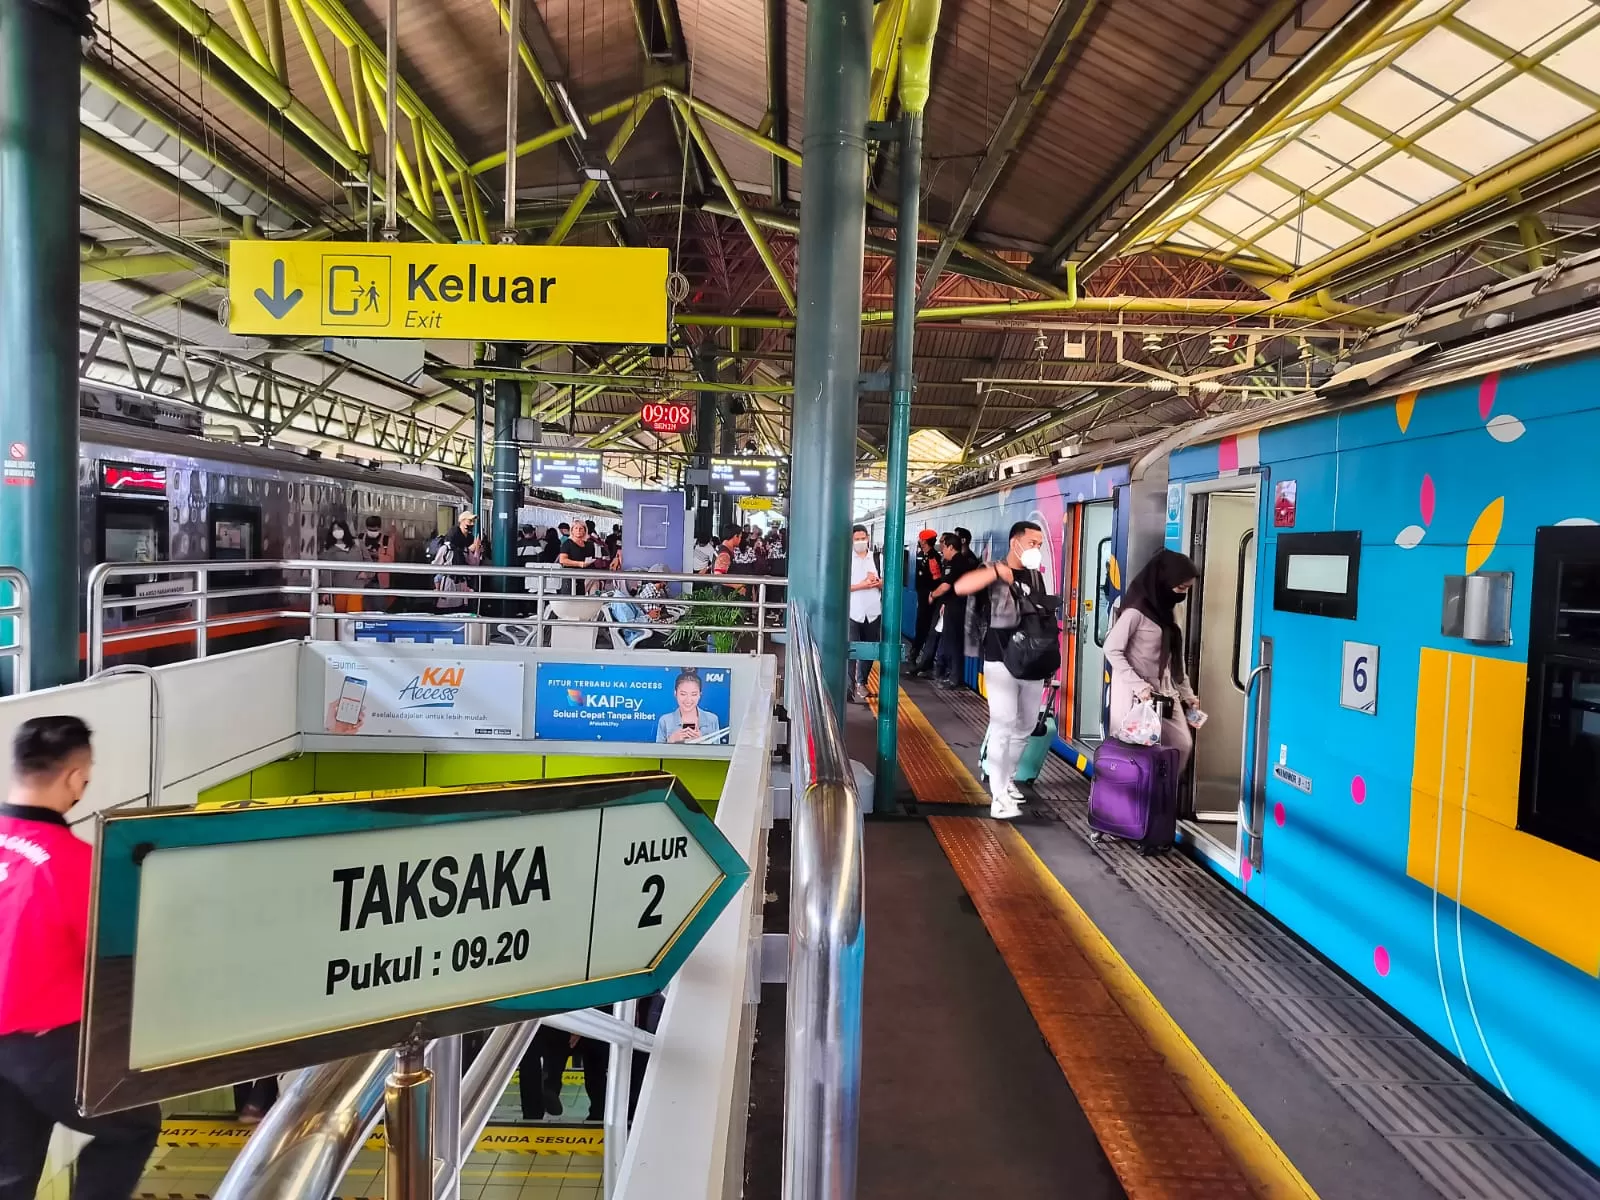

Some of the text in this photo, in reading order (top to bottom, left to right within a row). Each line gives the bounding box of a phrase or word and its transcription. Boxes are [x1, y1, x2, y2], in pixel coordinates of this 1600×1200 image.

[408, 263, 556, 305] Keluar
[404, 309, 443, 329] Exit
[642, 404, 690, 425] 09:08
[421, 666, 465, 687] KAI
[548, 679, 572, 687] FITUR
[574, 680, 611, 688] TERBARU
[629, 681, 663, 689] ACCESS
[706, 673, 724, 682] KAI
[1353, 656, 1368, 693] 6
[398, 675, 459, 701] Access
[586, 694, 643, 711] KAIPay
[553, 709, 578, 718] Solusi
[607, 711, 632, 721] Tanpa
[634, 712, 656, 721] Ribet
[623, 836, 688, 866] JALUR
[332, 845, 551, 932] TAKSAKA
[637, 874, 666, 928] 2
[326, 928, 529, 995] Pukul : 09.20
[482, 1135, 529, 1143] ANDA
[535, 1136, 593, 1144] SESUAI
